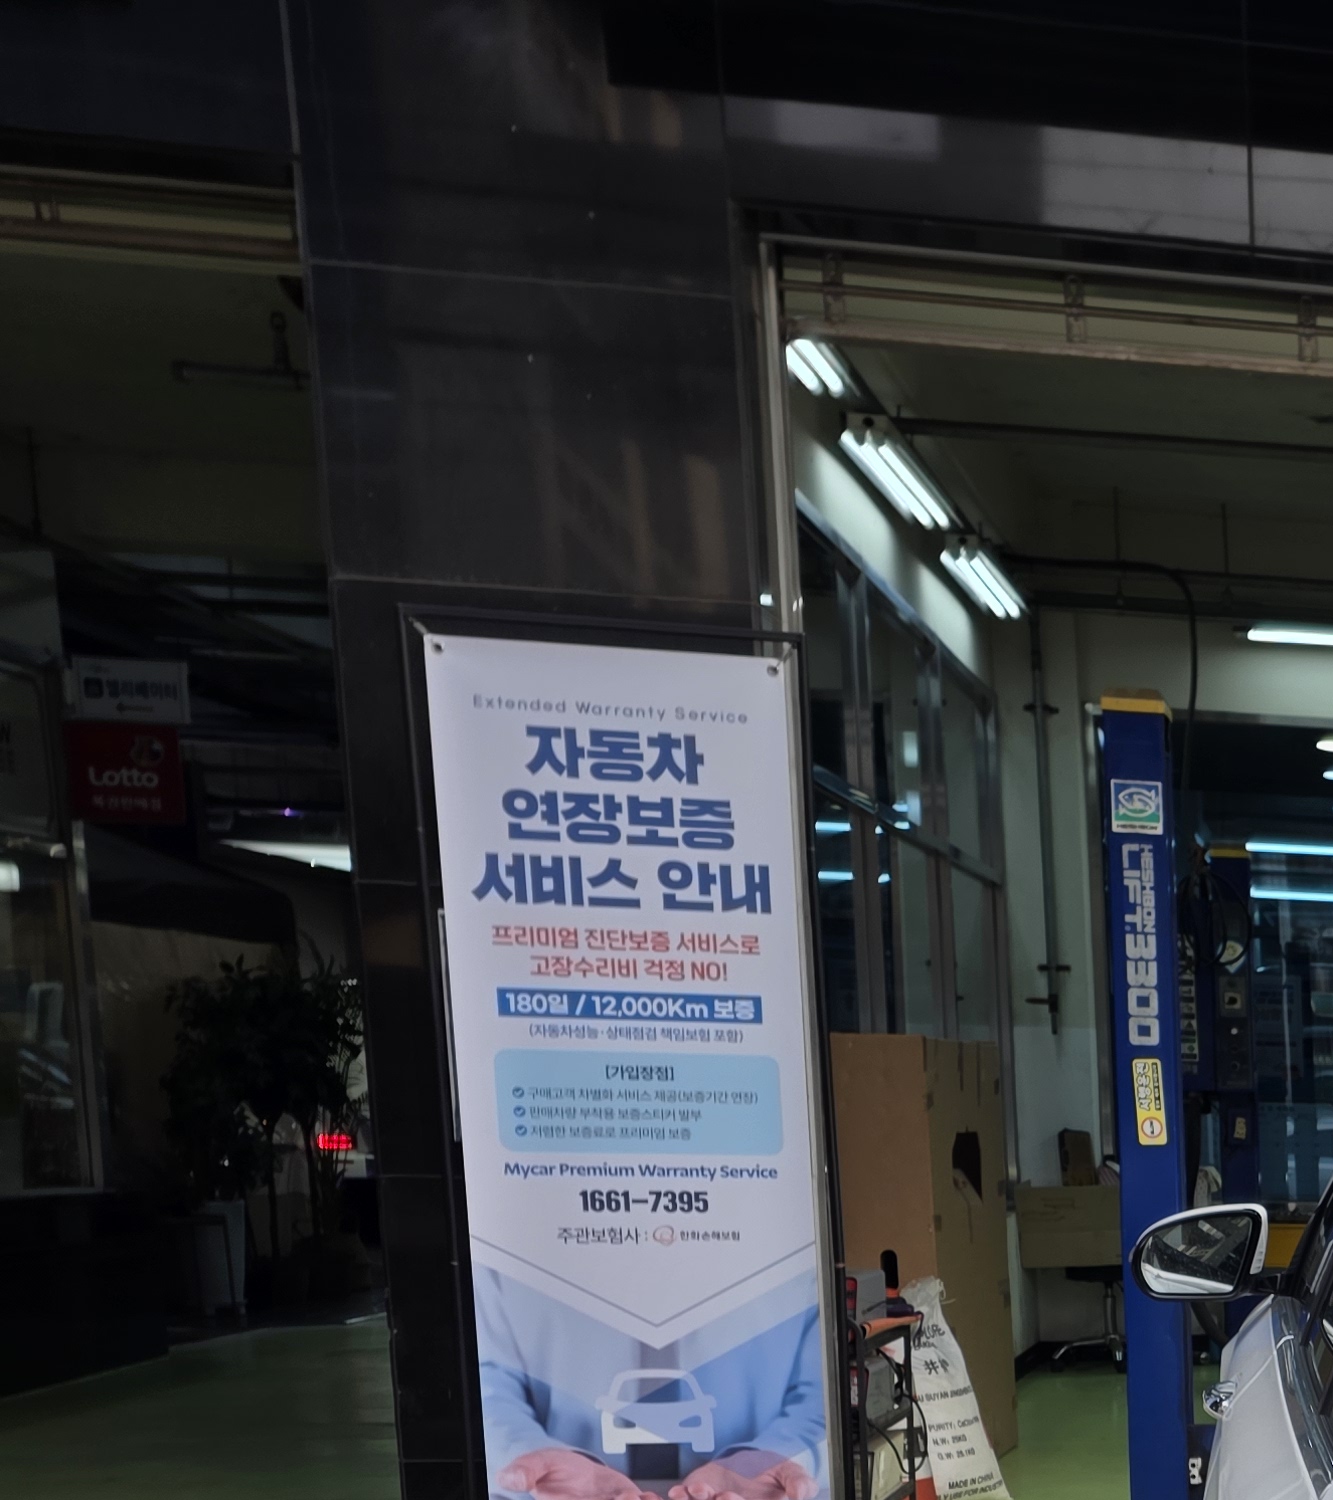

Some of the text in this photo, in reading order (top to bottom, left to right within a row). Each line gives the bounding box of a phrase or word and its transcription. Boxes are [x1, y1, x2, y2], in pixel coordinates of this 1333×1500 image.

[472, 693, 749, 725] Extended Warranty Service
[524, 724, 705, 786] 자동차
[88, 765, 160, 788] Lotto
[501, 788, 735, 851] 연장보증
[471, 852, 772, 915] 서비스 안내
[1140, 843, 1156, 934] HESHBON
[491, 924, 762, 956] 프리미엄 진단보증 서비스로
[529, 954, 729, 982] 고장수리비 걱정 NO!
[1125, 933, 1161, 1046] 3300
[505, 991, 569, 1016] 180일
[591, 995, 709, 1020] 12,000Km
[713, 998, 756, 1021] 보증
[503, 1161, 778, 1182] Mycar Premium Warranty Service
[579, 1189, 710, 1214] 1661-7395
[948, 1479, 968, 1490] MADE
[969, 1477, 977, 1486] IN
